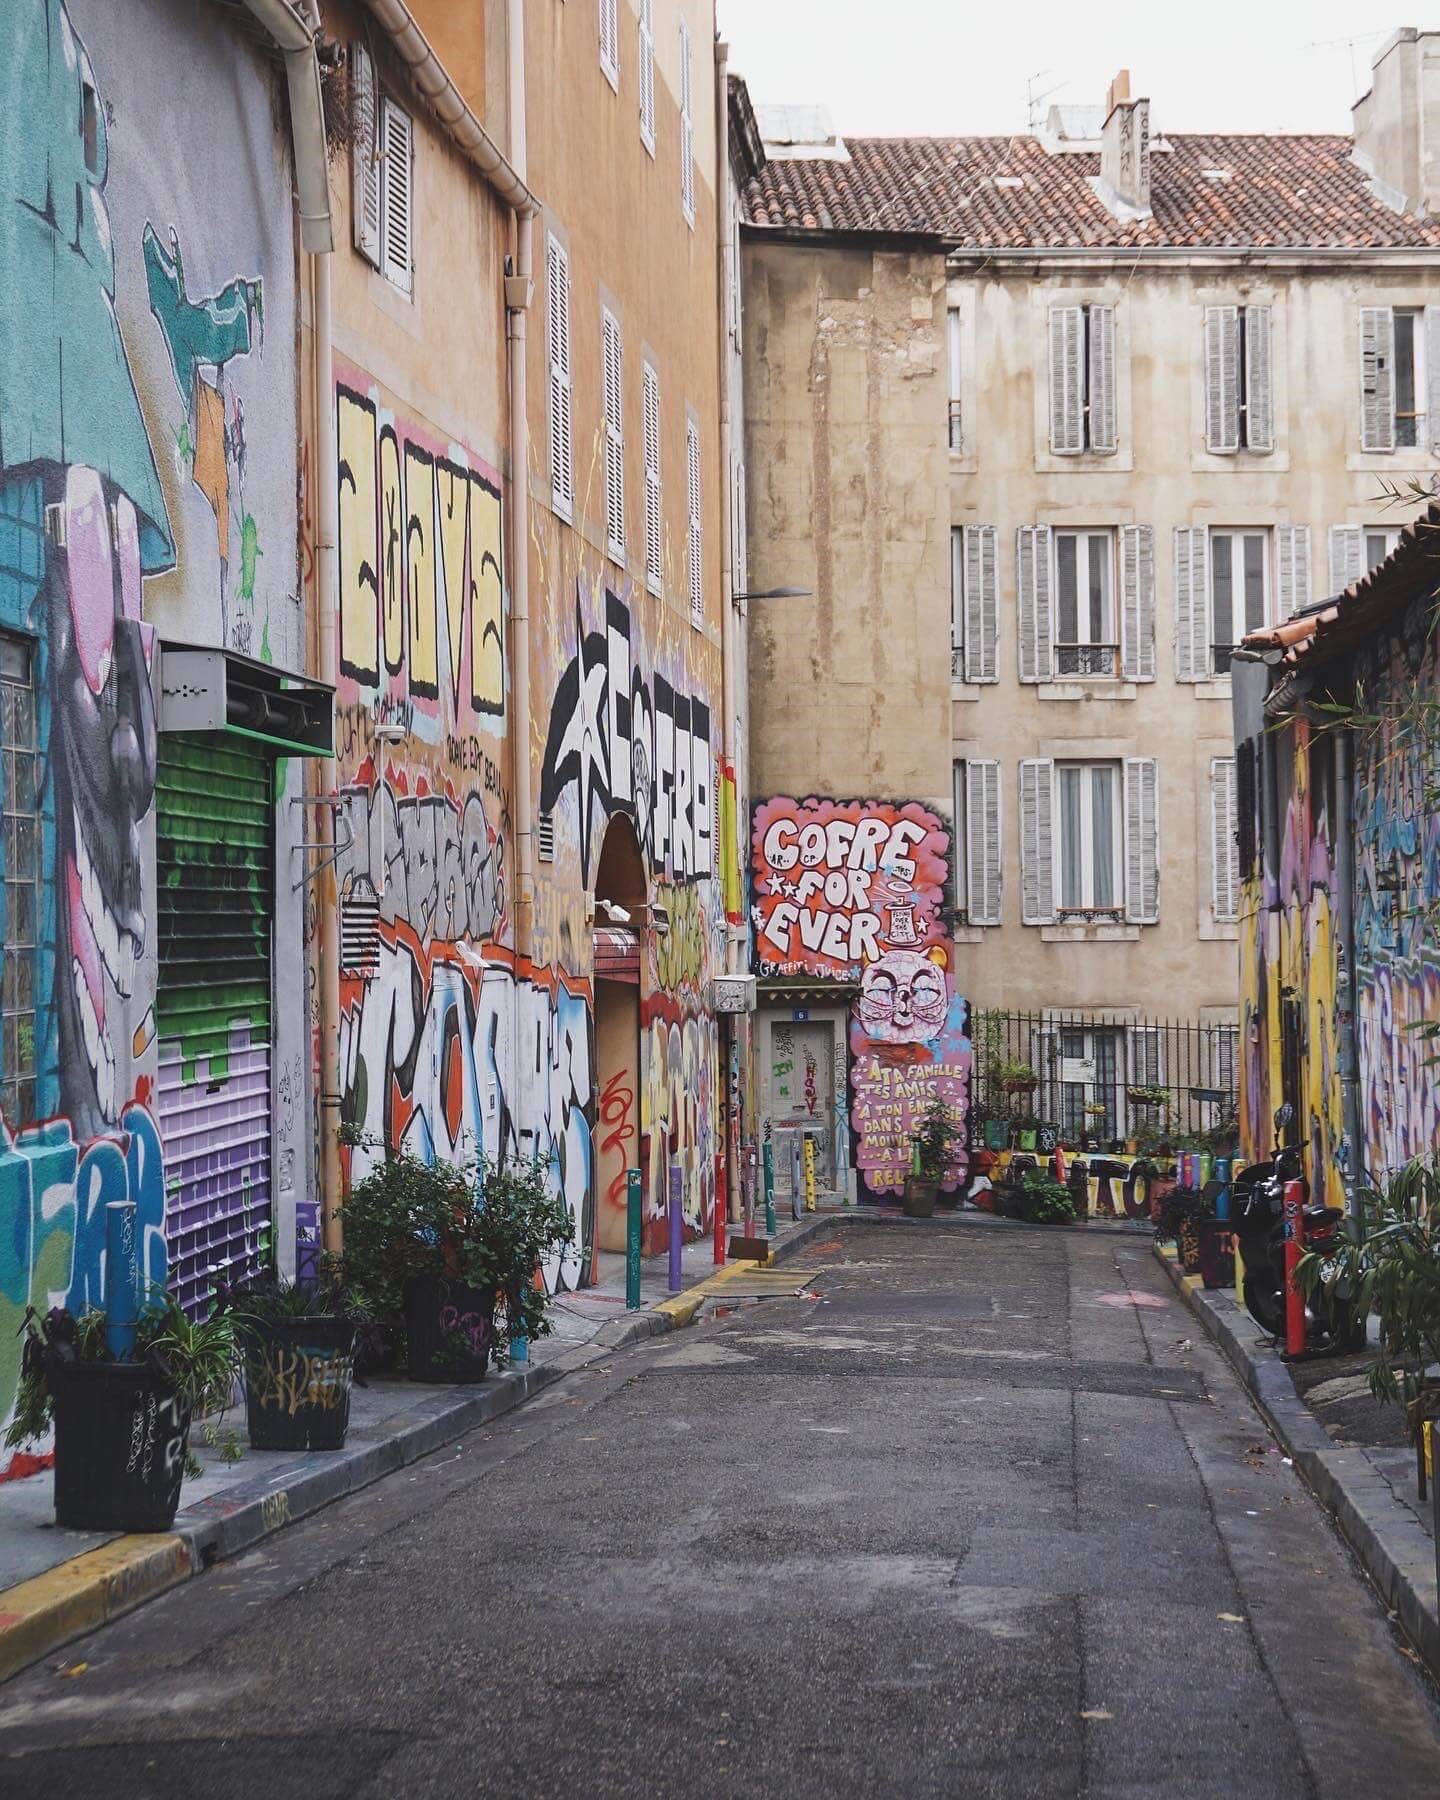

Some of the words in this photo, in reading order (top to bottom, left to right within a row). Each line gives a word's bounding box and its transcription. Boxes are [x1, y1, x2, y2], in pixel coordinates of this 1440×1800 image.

[764, 817, 928, 882] COFRE
[794, 869, 872, 911] FOR
[764, 902, 881, 962] EVER
[859, 1083, 891, 1099] TES
[875, 1104, 903, 1116] TON
[864, 1117, 902, 1133] DANS
